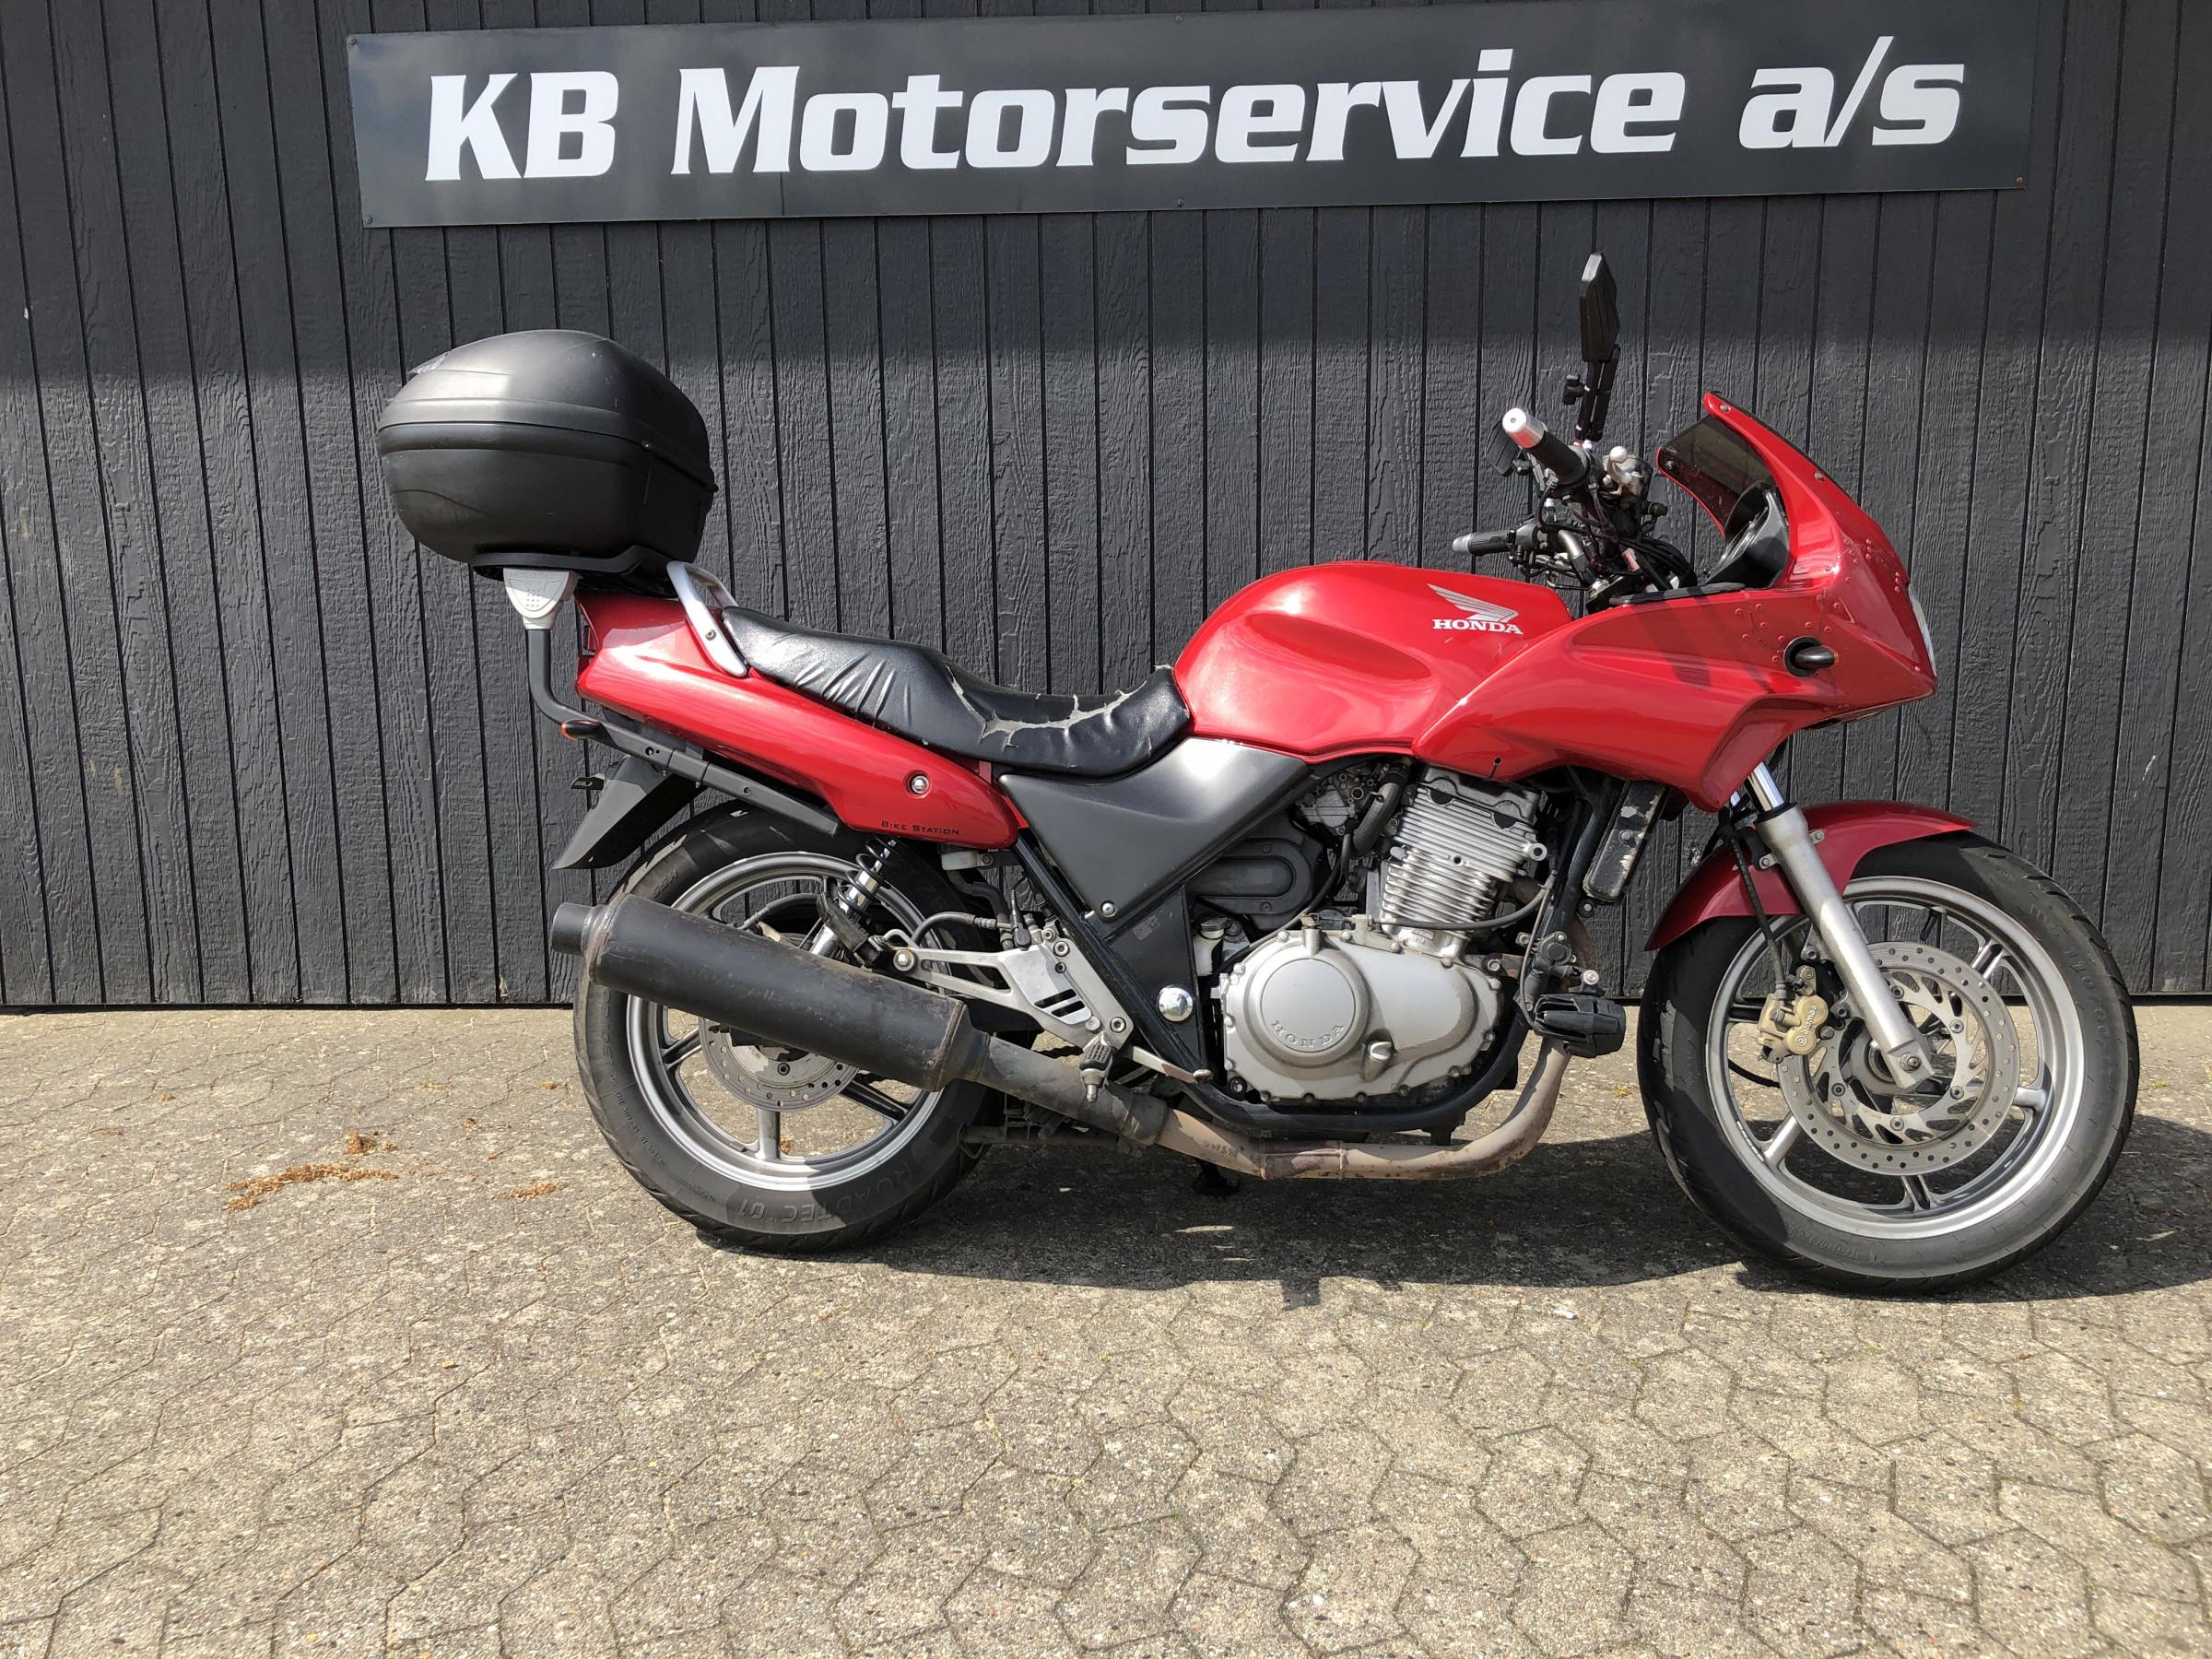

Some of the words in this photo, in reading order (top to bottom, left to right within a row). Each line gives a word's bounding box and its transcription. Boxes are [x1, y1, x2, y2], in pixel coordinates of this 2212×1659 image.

[425, 71, 619, 181] KB
[671, 49, 1686, 175] Motorservice
[1739, 36, 1966, 148] a/s
[1432, 618, 1524, 635] HONDA
[1270, 1019, 1346, 1048] HONDA
